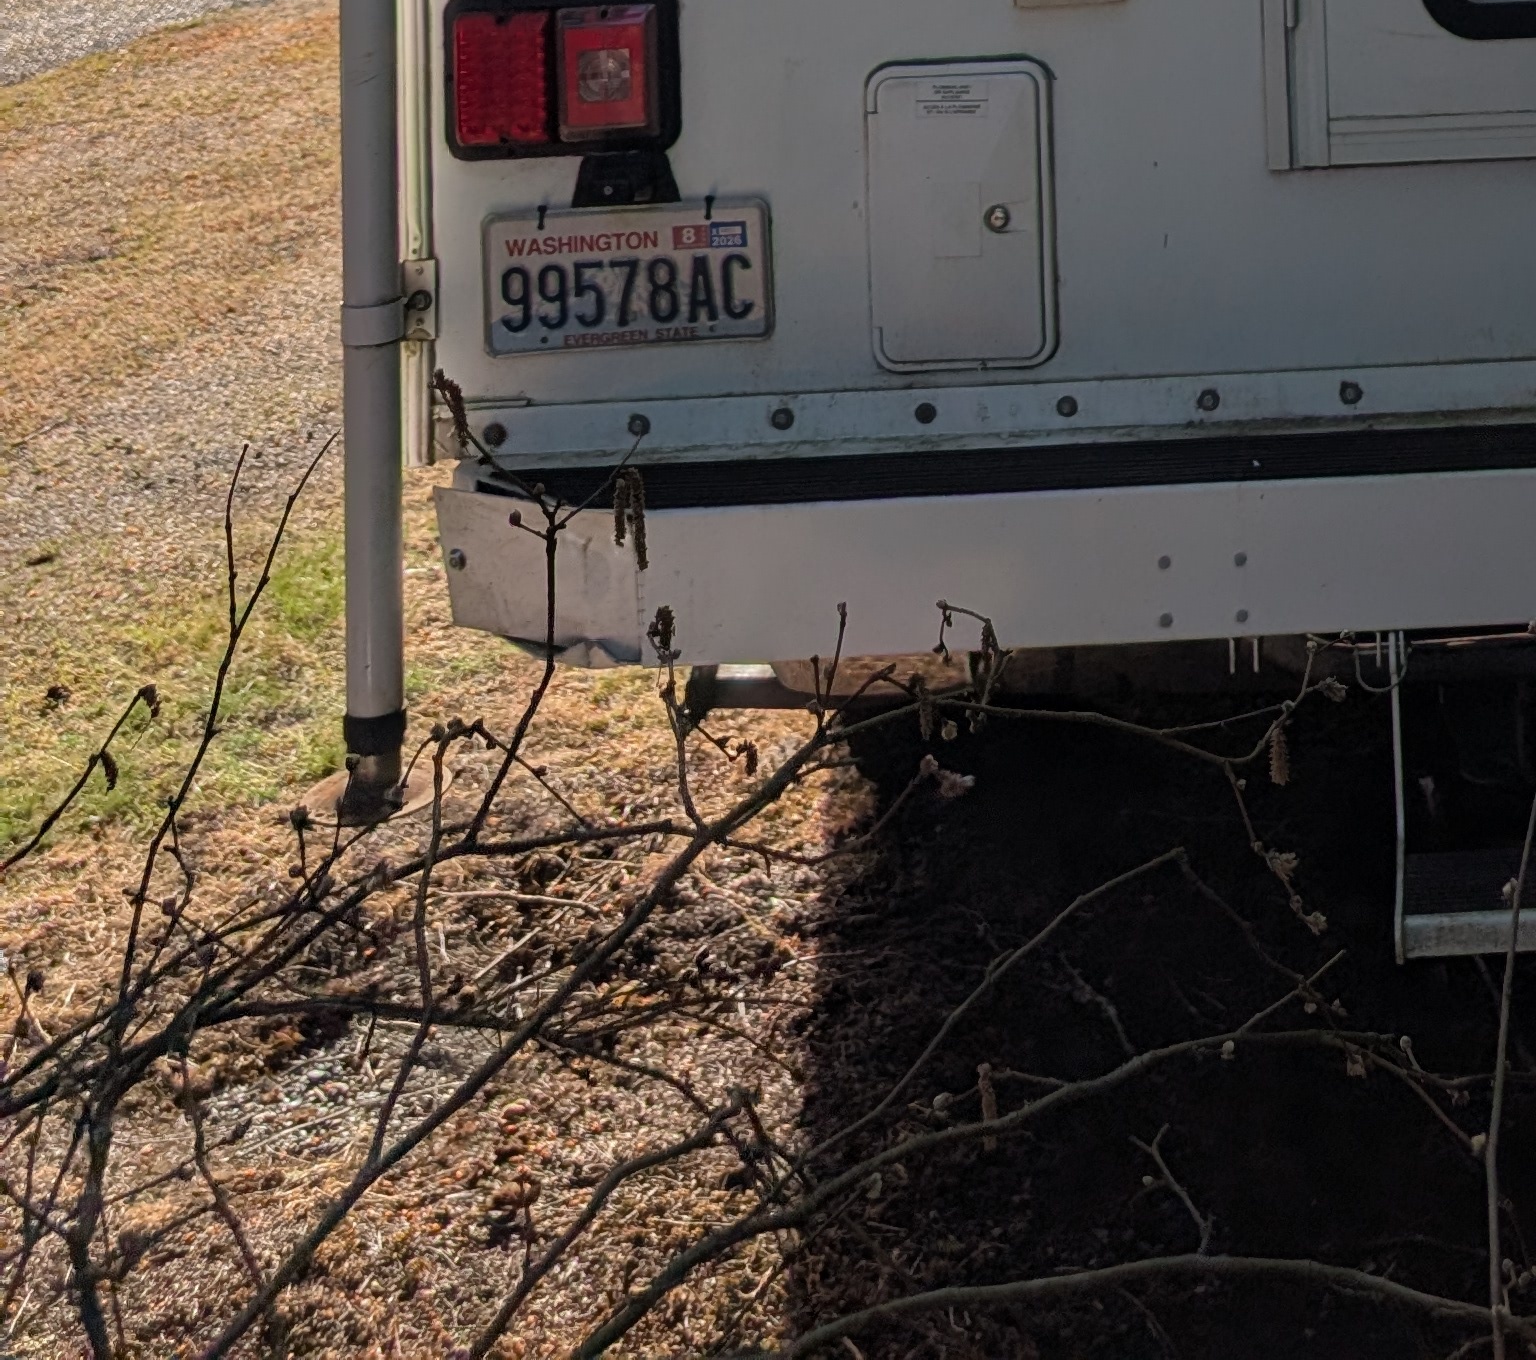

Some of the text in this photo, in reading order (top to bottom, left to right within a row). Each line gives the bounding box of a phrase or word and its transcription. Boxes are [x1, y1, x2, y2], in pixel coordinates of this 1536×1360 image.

[505, 230, 659, 257] WASHINGTON
[681, 227, 697, 244] 8
[500, 253, 756, 334] 99578AC
[562, 325, 700, 347] EVERGREEN STATE
